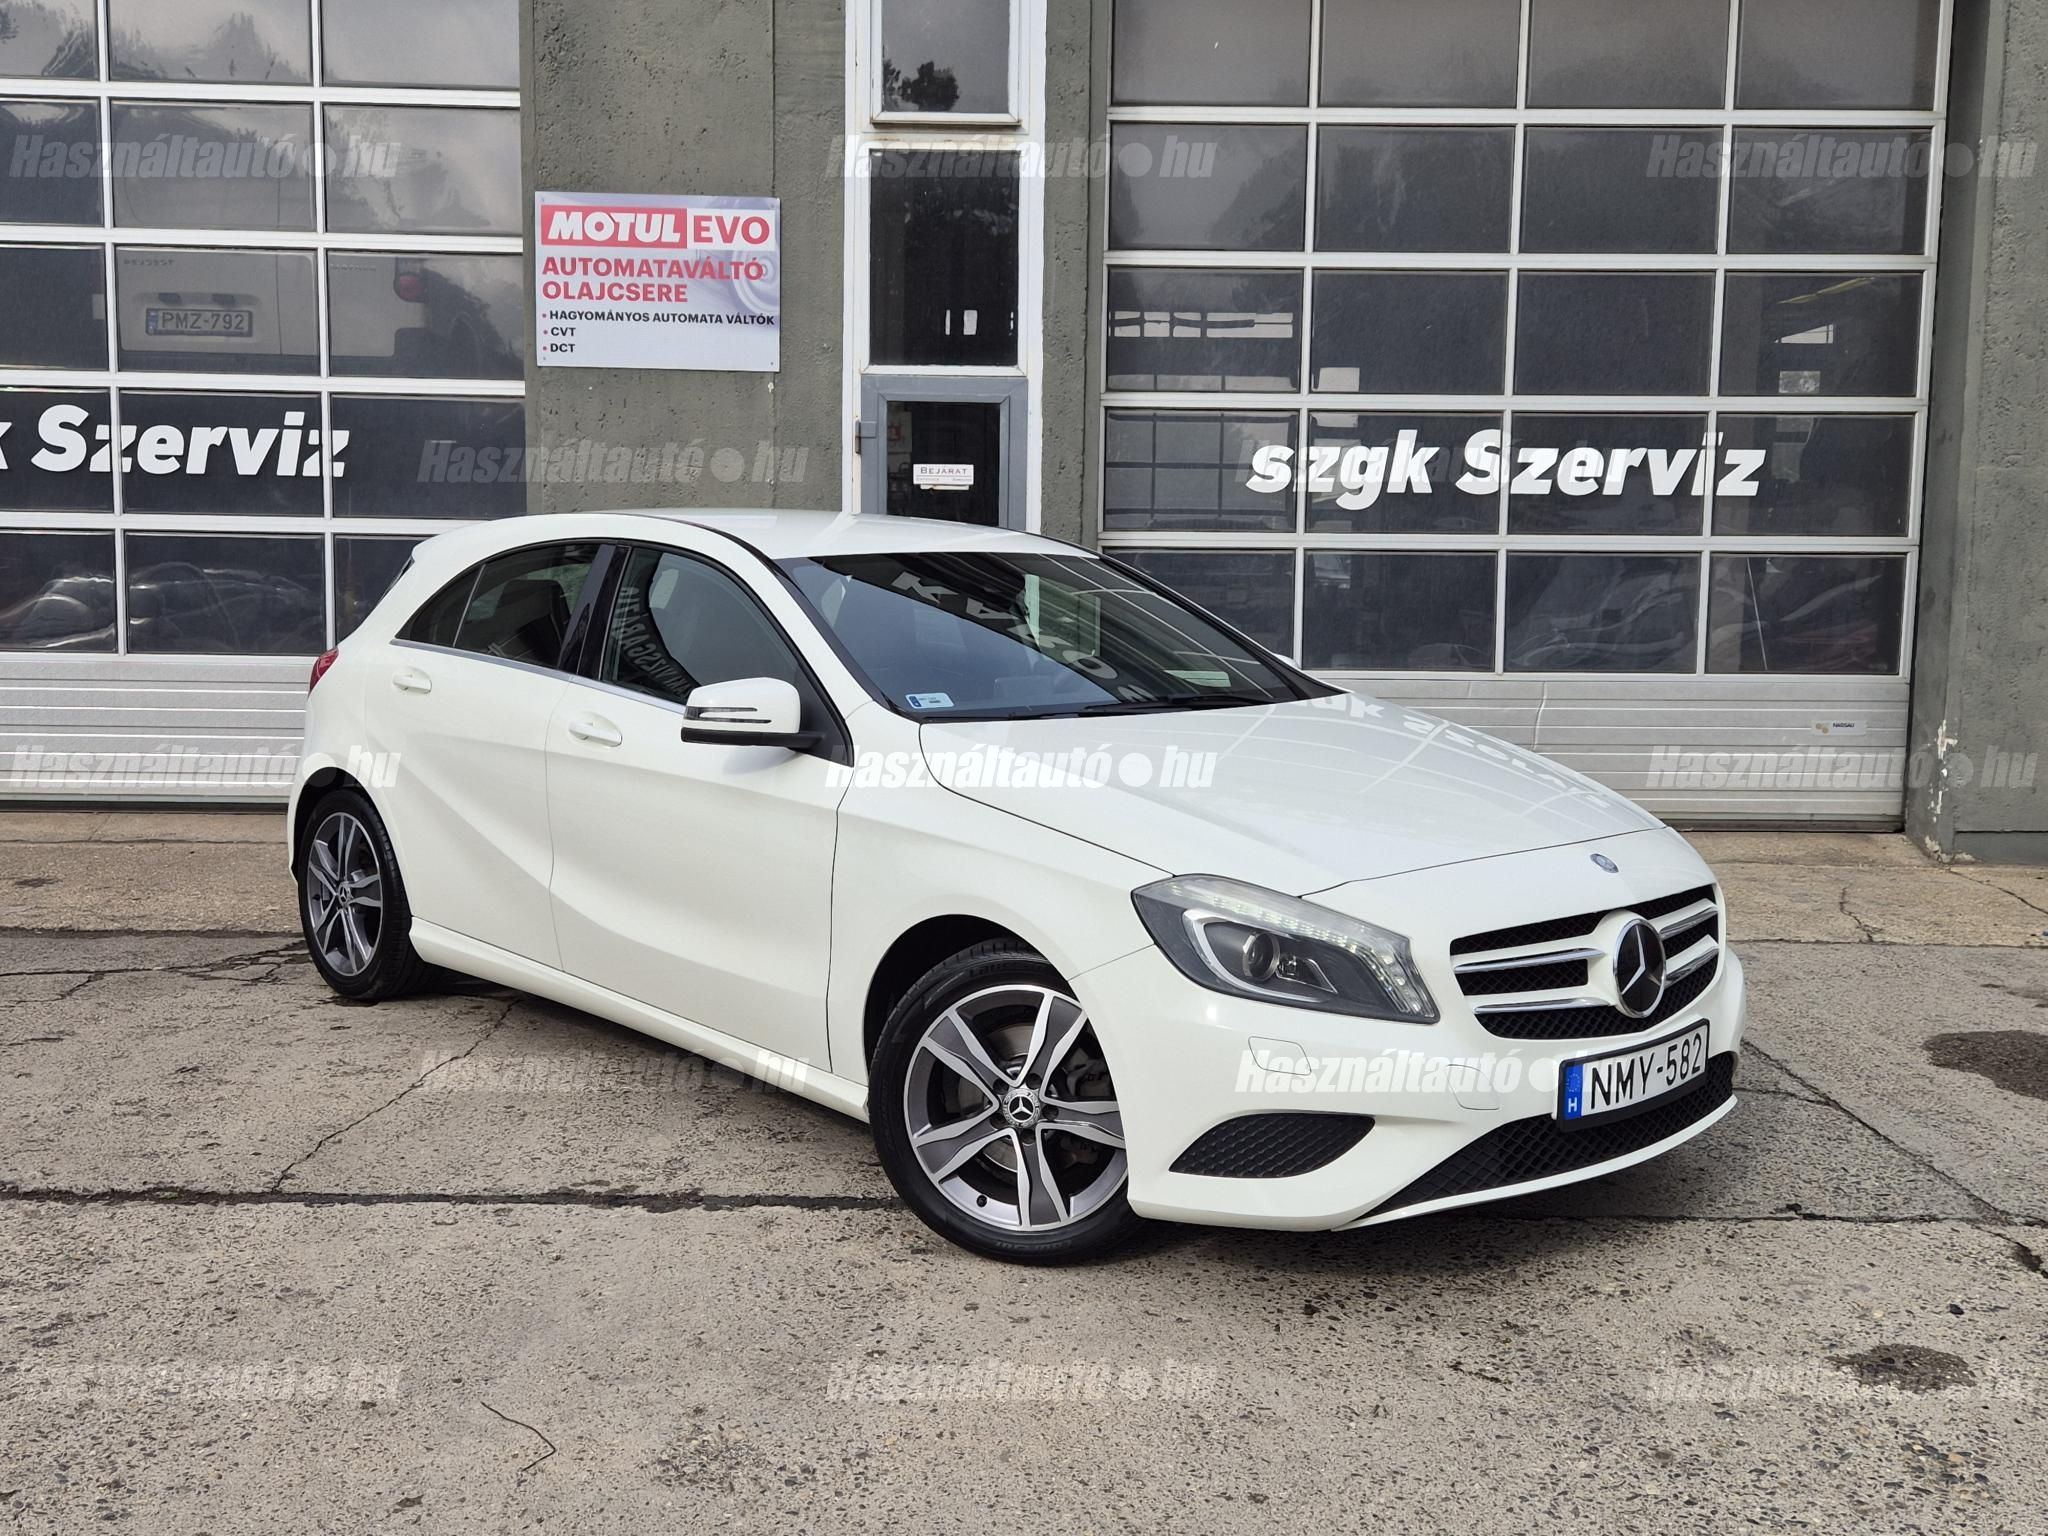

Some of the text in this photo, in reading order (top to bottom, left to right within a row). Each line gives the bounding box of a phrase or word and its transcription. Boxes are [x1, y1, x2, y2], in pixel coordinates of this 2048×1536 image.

[547, 211, 770, 245] MOTUL EVO
[542, 256, 764, 281] AUTOMATAVÁLTÓ
[542, 281, 688, 302] OLAJCSERE
[161, 310, 245, 331] PMZ-792
[549, 310, 775, 325] HAGYOMÁNYOS AUTOMATA VÁLTÓK
[550, 327, 576, 337] CVT
[550, 343, 575, 353] DCT
[30, 404, 350, 478] Szerviz
[1246, 429, 1767, 511] szgk Szerviz
[1591, 1032, 1702, 1110] NMY-582
[1568, 1097, 1578, 1113] H
